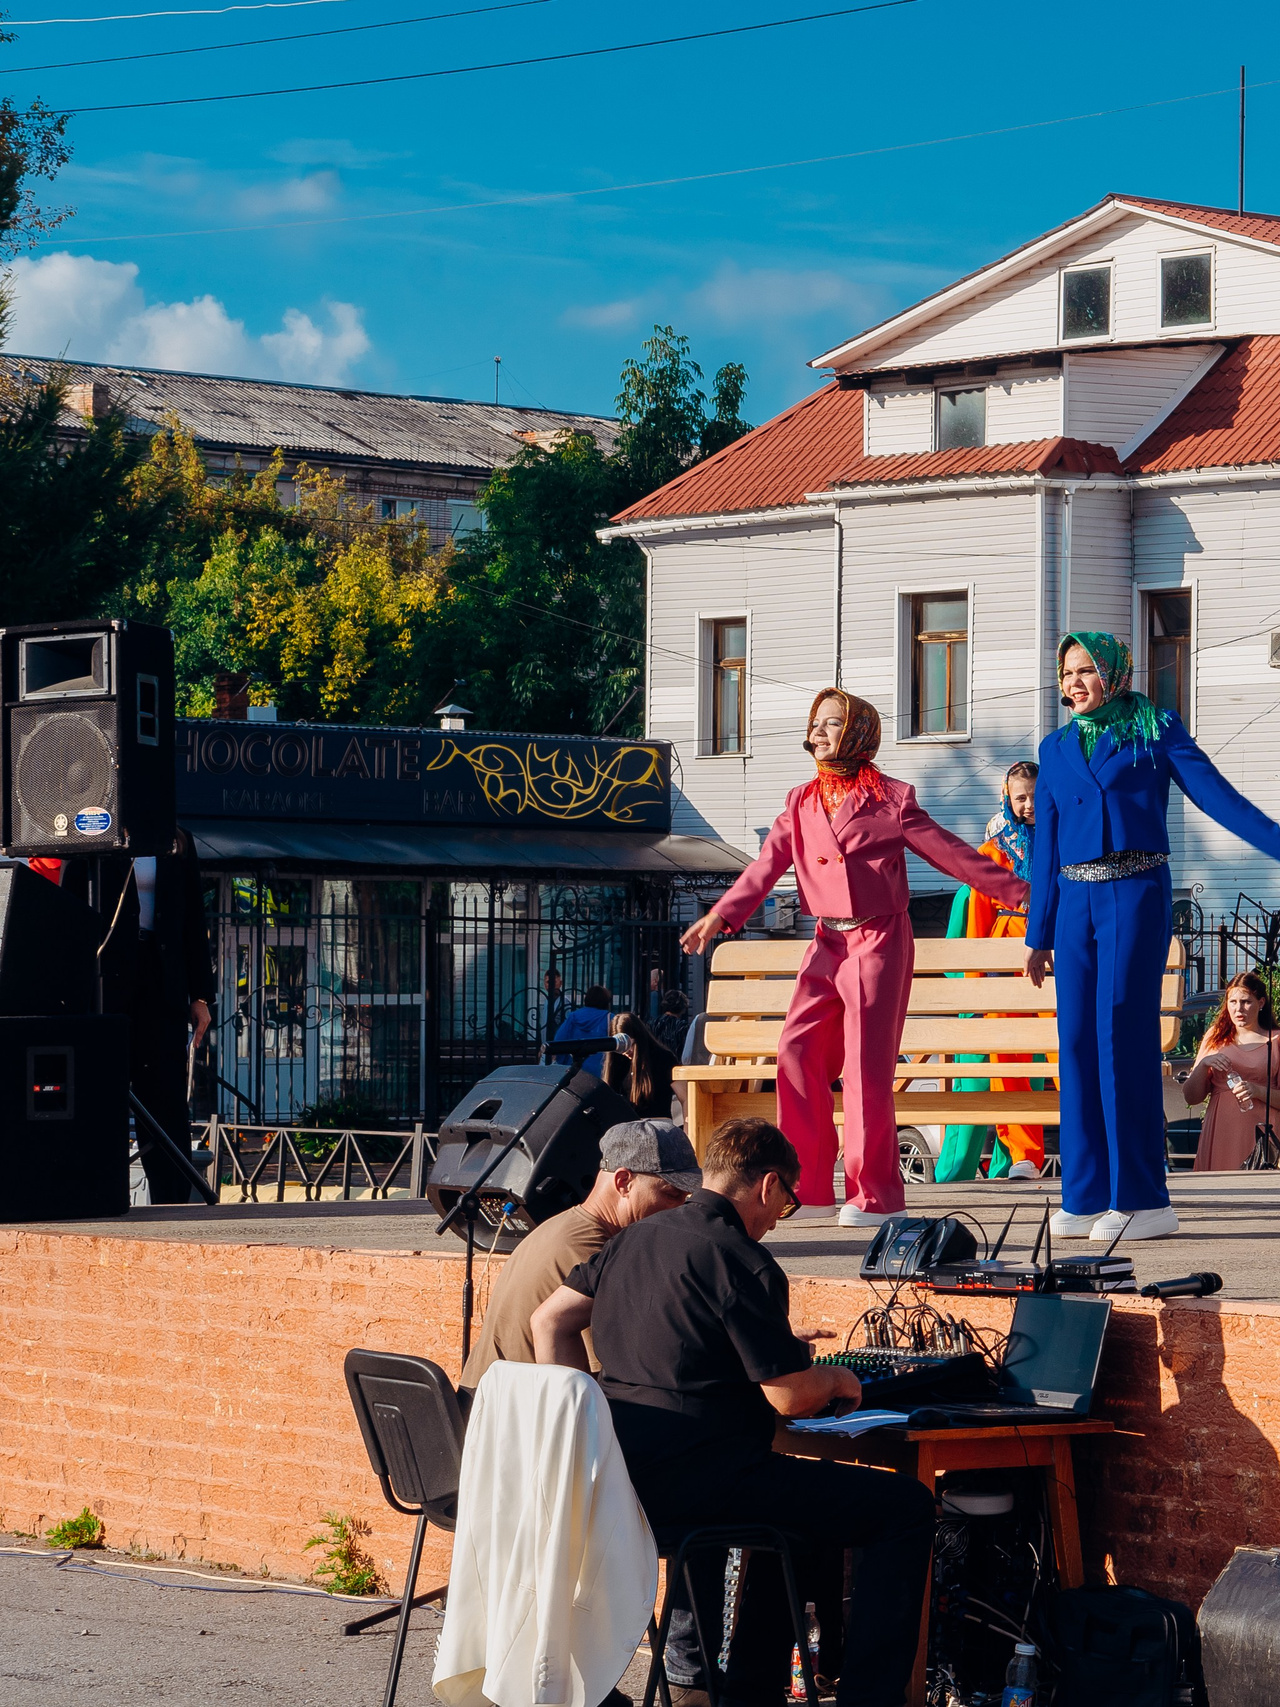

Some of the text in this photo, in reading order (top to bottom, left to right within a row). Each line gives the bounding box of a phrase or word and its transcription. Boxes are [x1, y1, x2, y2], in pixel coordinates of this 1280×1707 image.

[175, 729, 420, 781] HOCOLATE
[222, 788, 476, 815] KARAOKE BAR
